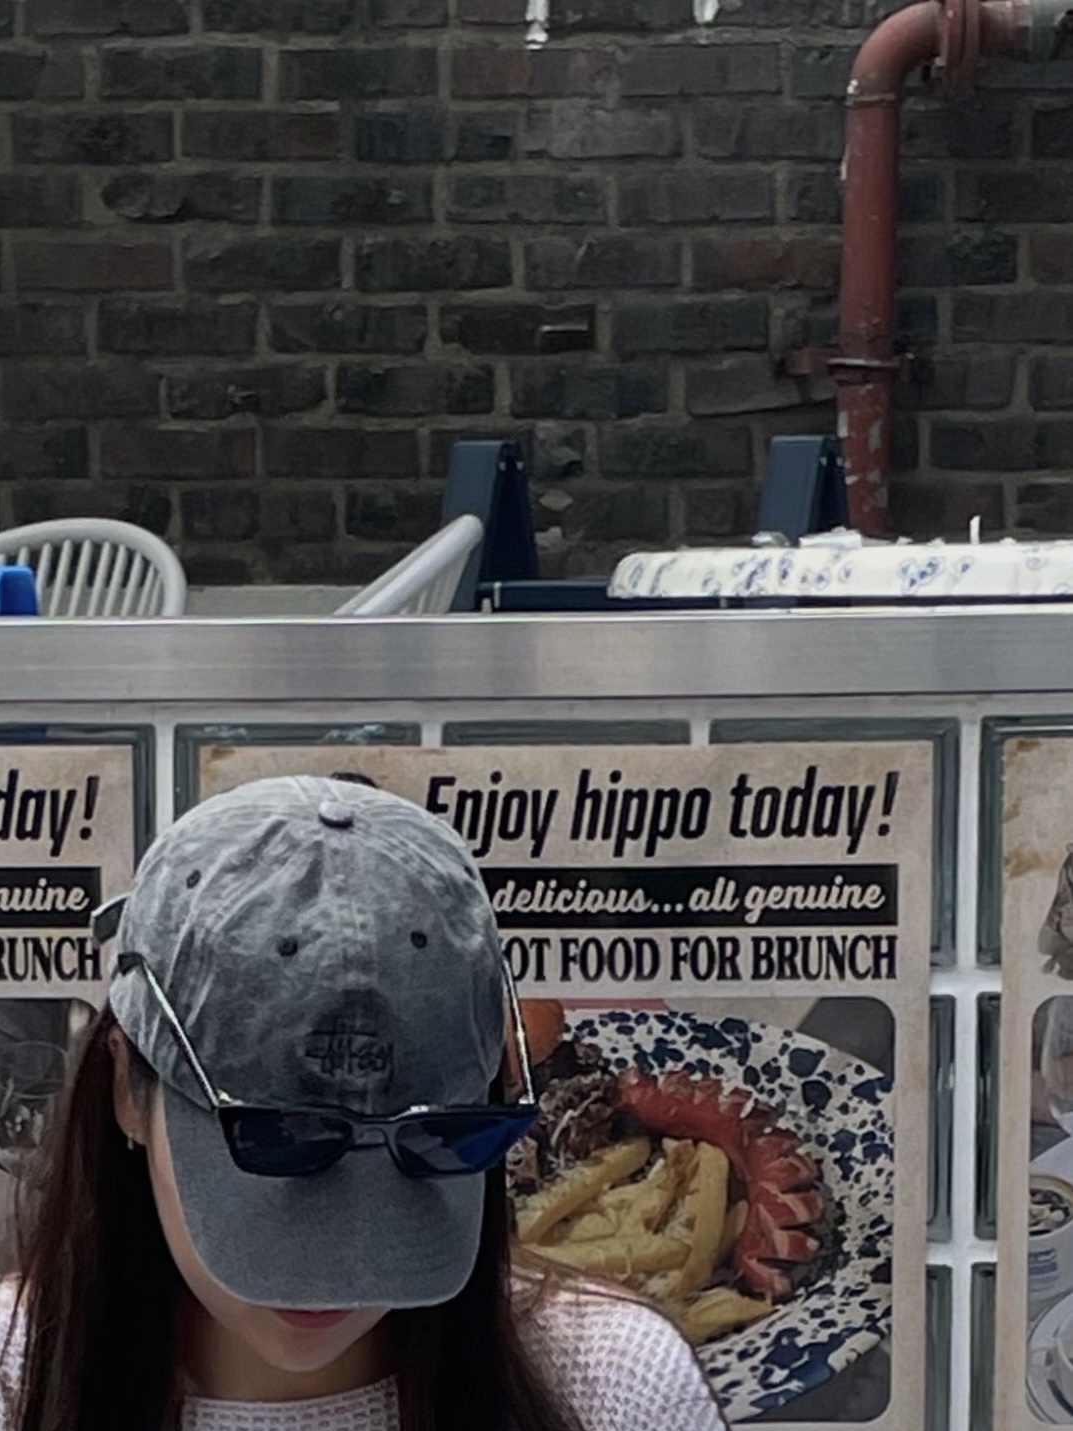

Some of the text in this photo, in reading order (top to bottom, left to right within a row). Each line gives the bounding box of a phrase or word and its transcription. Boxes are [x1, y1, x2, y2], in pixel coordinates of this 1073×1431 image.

[425, 765, 900, 859] Enjoy hippo today!
[744, 875, 886, 924] genuine
[502, 934, 898, 983] OT FOOD FOR BRUNCH
